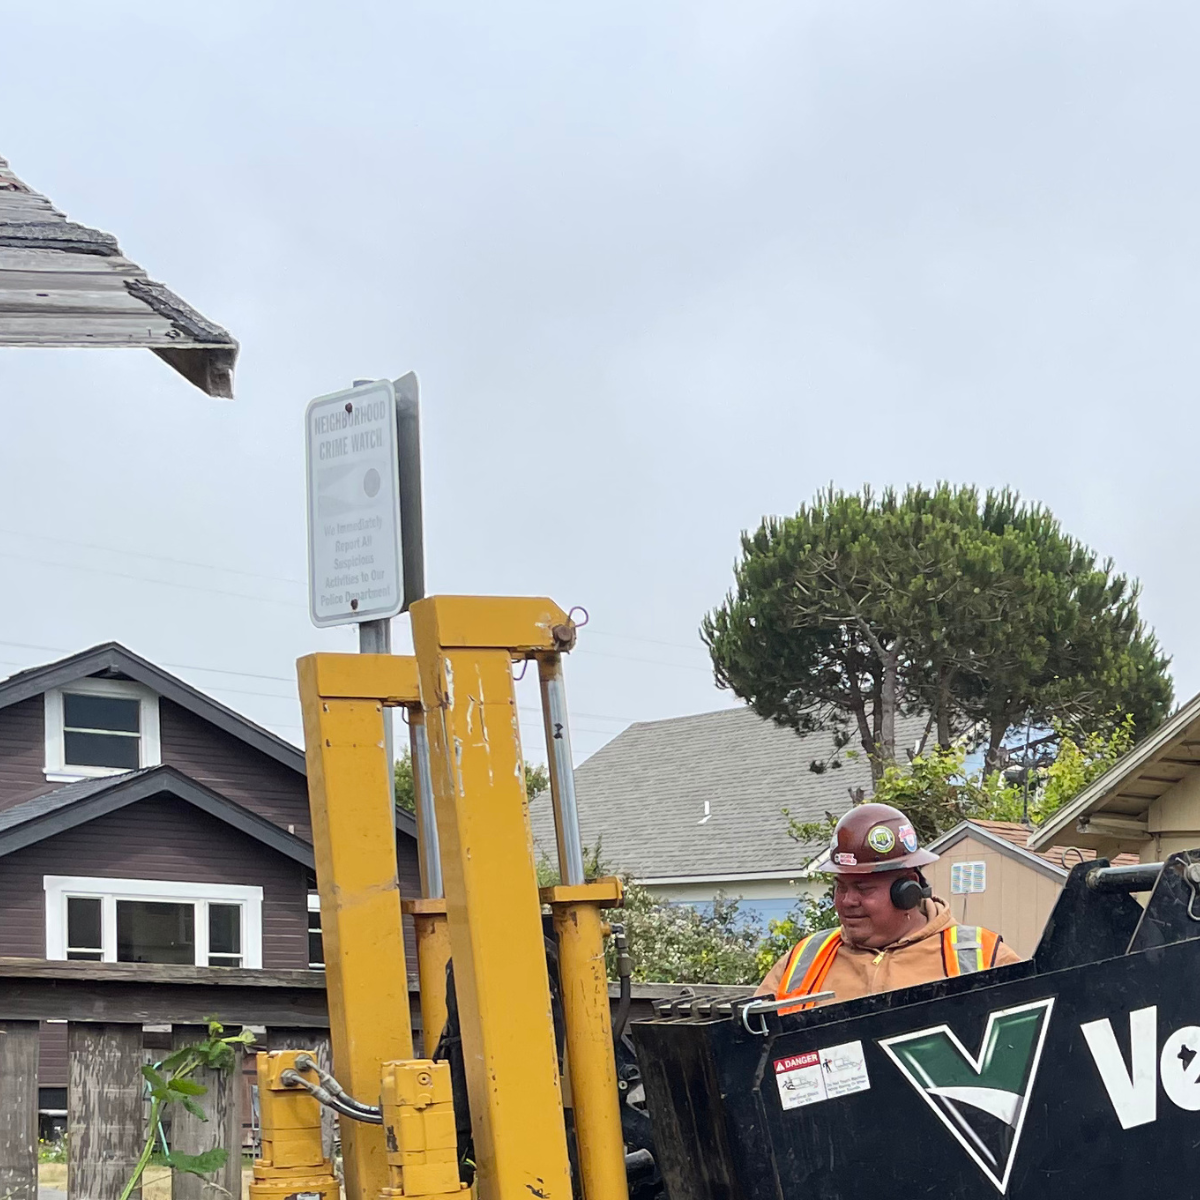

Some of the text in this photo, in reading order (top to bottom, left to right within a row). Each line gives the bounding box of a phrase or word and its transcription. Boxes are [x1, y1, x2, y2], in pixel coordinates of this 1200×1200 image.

[314, 401, 386, 435] NEIGHBORHOOD
[319, 428, 382, 460] CRIME WATCH
[324, 515, 382, 536] We Immediately
[335, 535, 372, 553] Report All
[334, 554, 374, 570] Suspicious
[325, 570, 384, 588] Activities to Our
[320, 585, 391, 606] Police Department
[785, 1054, 818, 1069] DANGER
